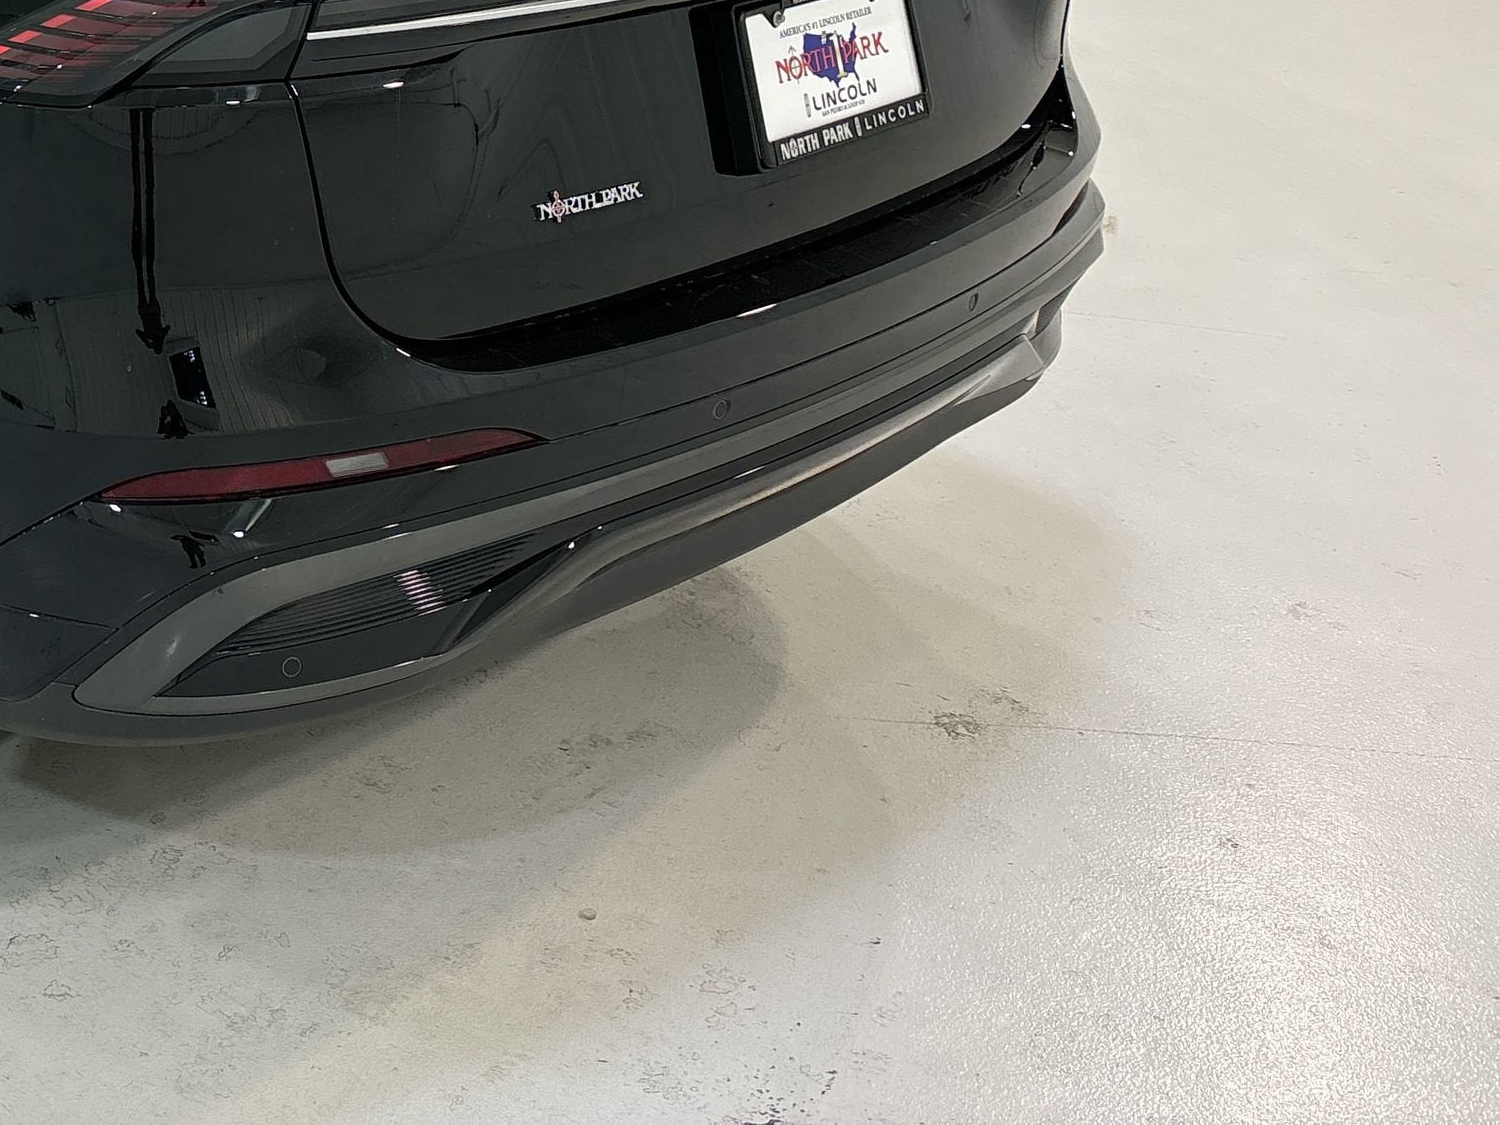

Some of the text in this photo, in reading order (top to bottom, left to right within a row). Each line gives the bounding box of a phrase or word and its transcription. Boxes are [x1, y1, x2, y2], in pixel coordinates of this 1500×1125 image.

[779, 21, 812, 39] AMERICA'S
[819, 12, 847, 28] LINCOLN
[845, 6, 873, 21] RETAILER
[775, 31, 889, 84] NORTH PARK
[812, 78, 877, 111] LINCOLN
[779, 99, 925, 161] NORTH PARK LINCOLN
[536, 181, 644, 223] NORTH PARK
